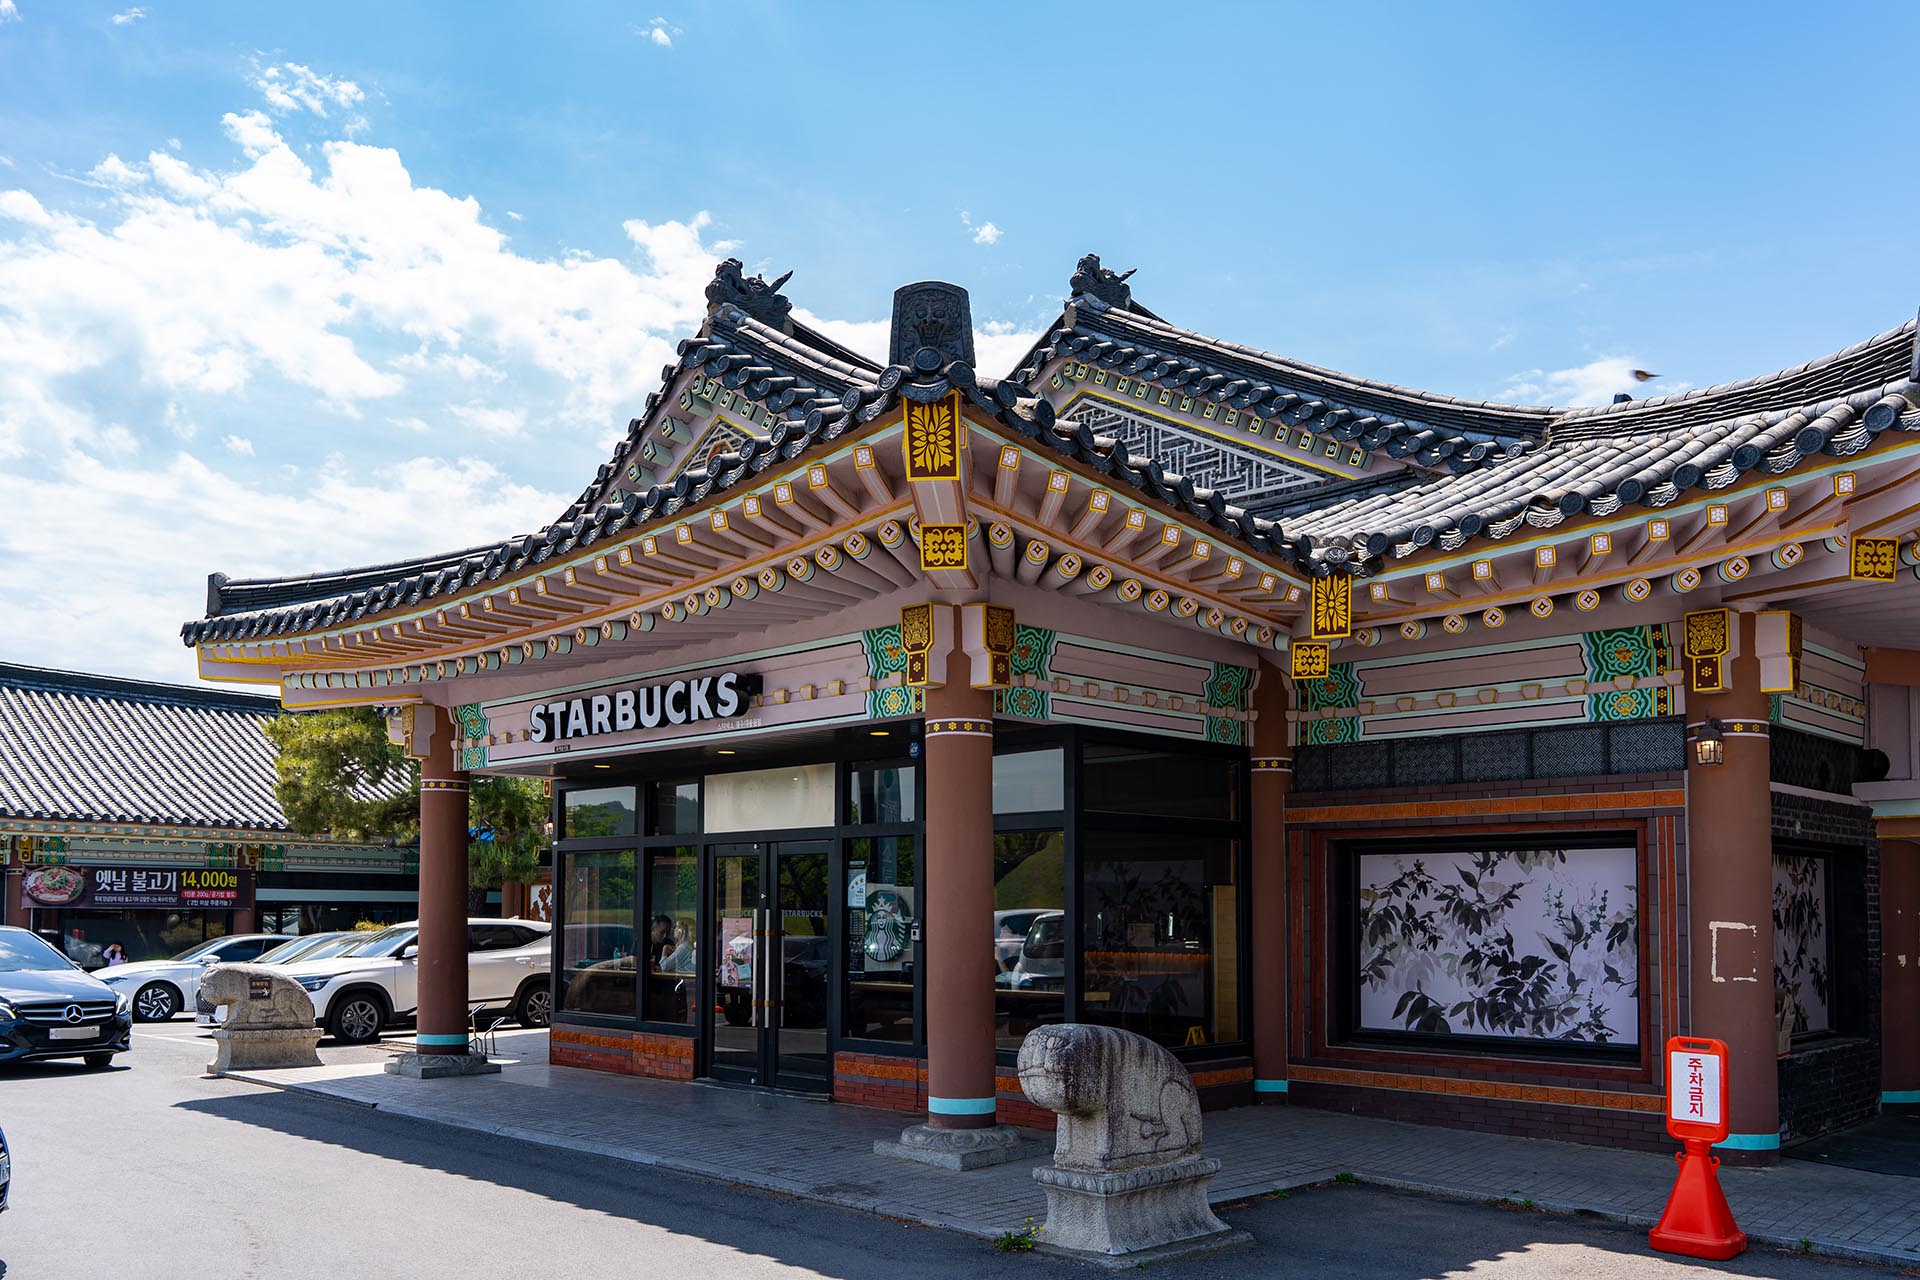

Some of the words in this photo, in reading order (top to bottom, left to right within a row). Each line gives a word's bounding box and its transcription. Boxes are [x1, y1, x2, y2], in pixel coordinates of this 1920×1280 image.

[529, 671, 740, 743] STARBUCKS
[95, 869, 127, 892] 옛날
[131, 871, 177, 892] 불고기
[181, 871, 238, 889] 14,000원
[784, 909, 823, 918] STARBUCKS
[1688, 1057, 1704, 1117] 주차금지
